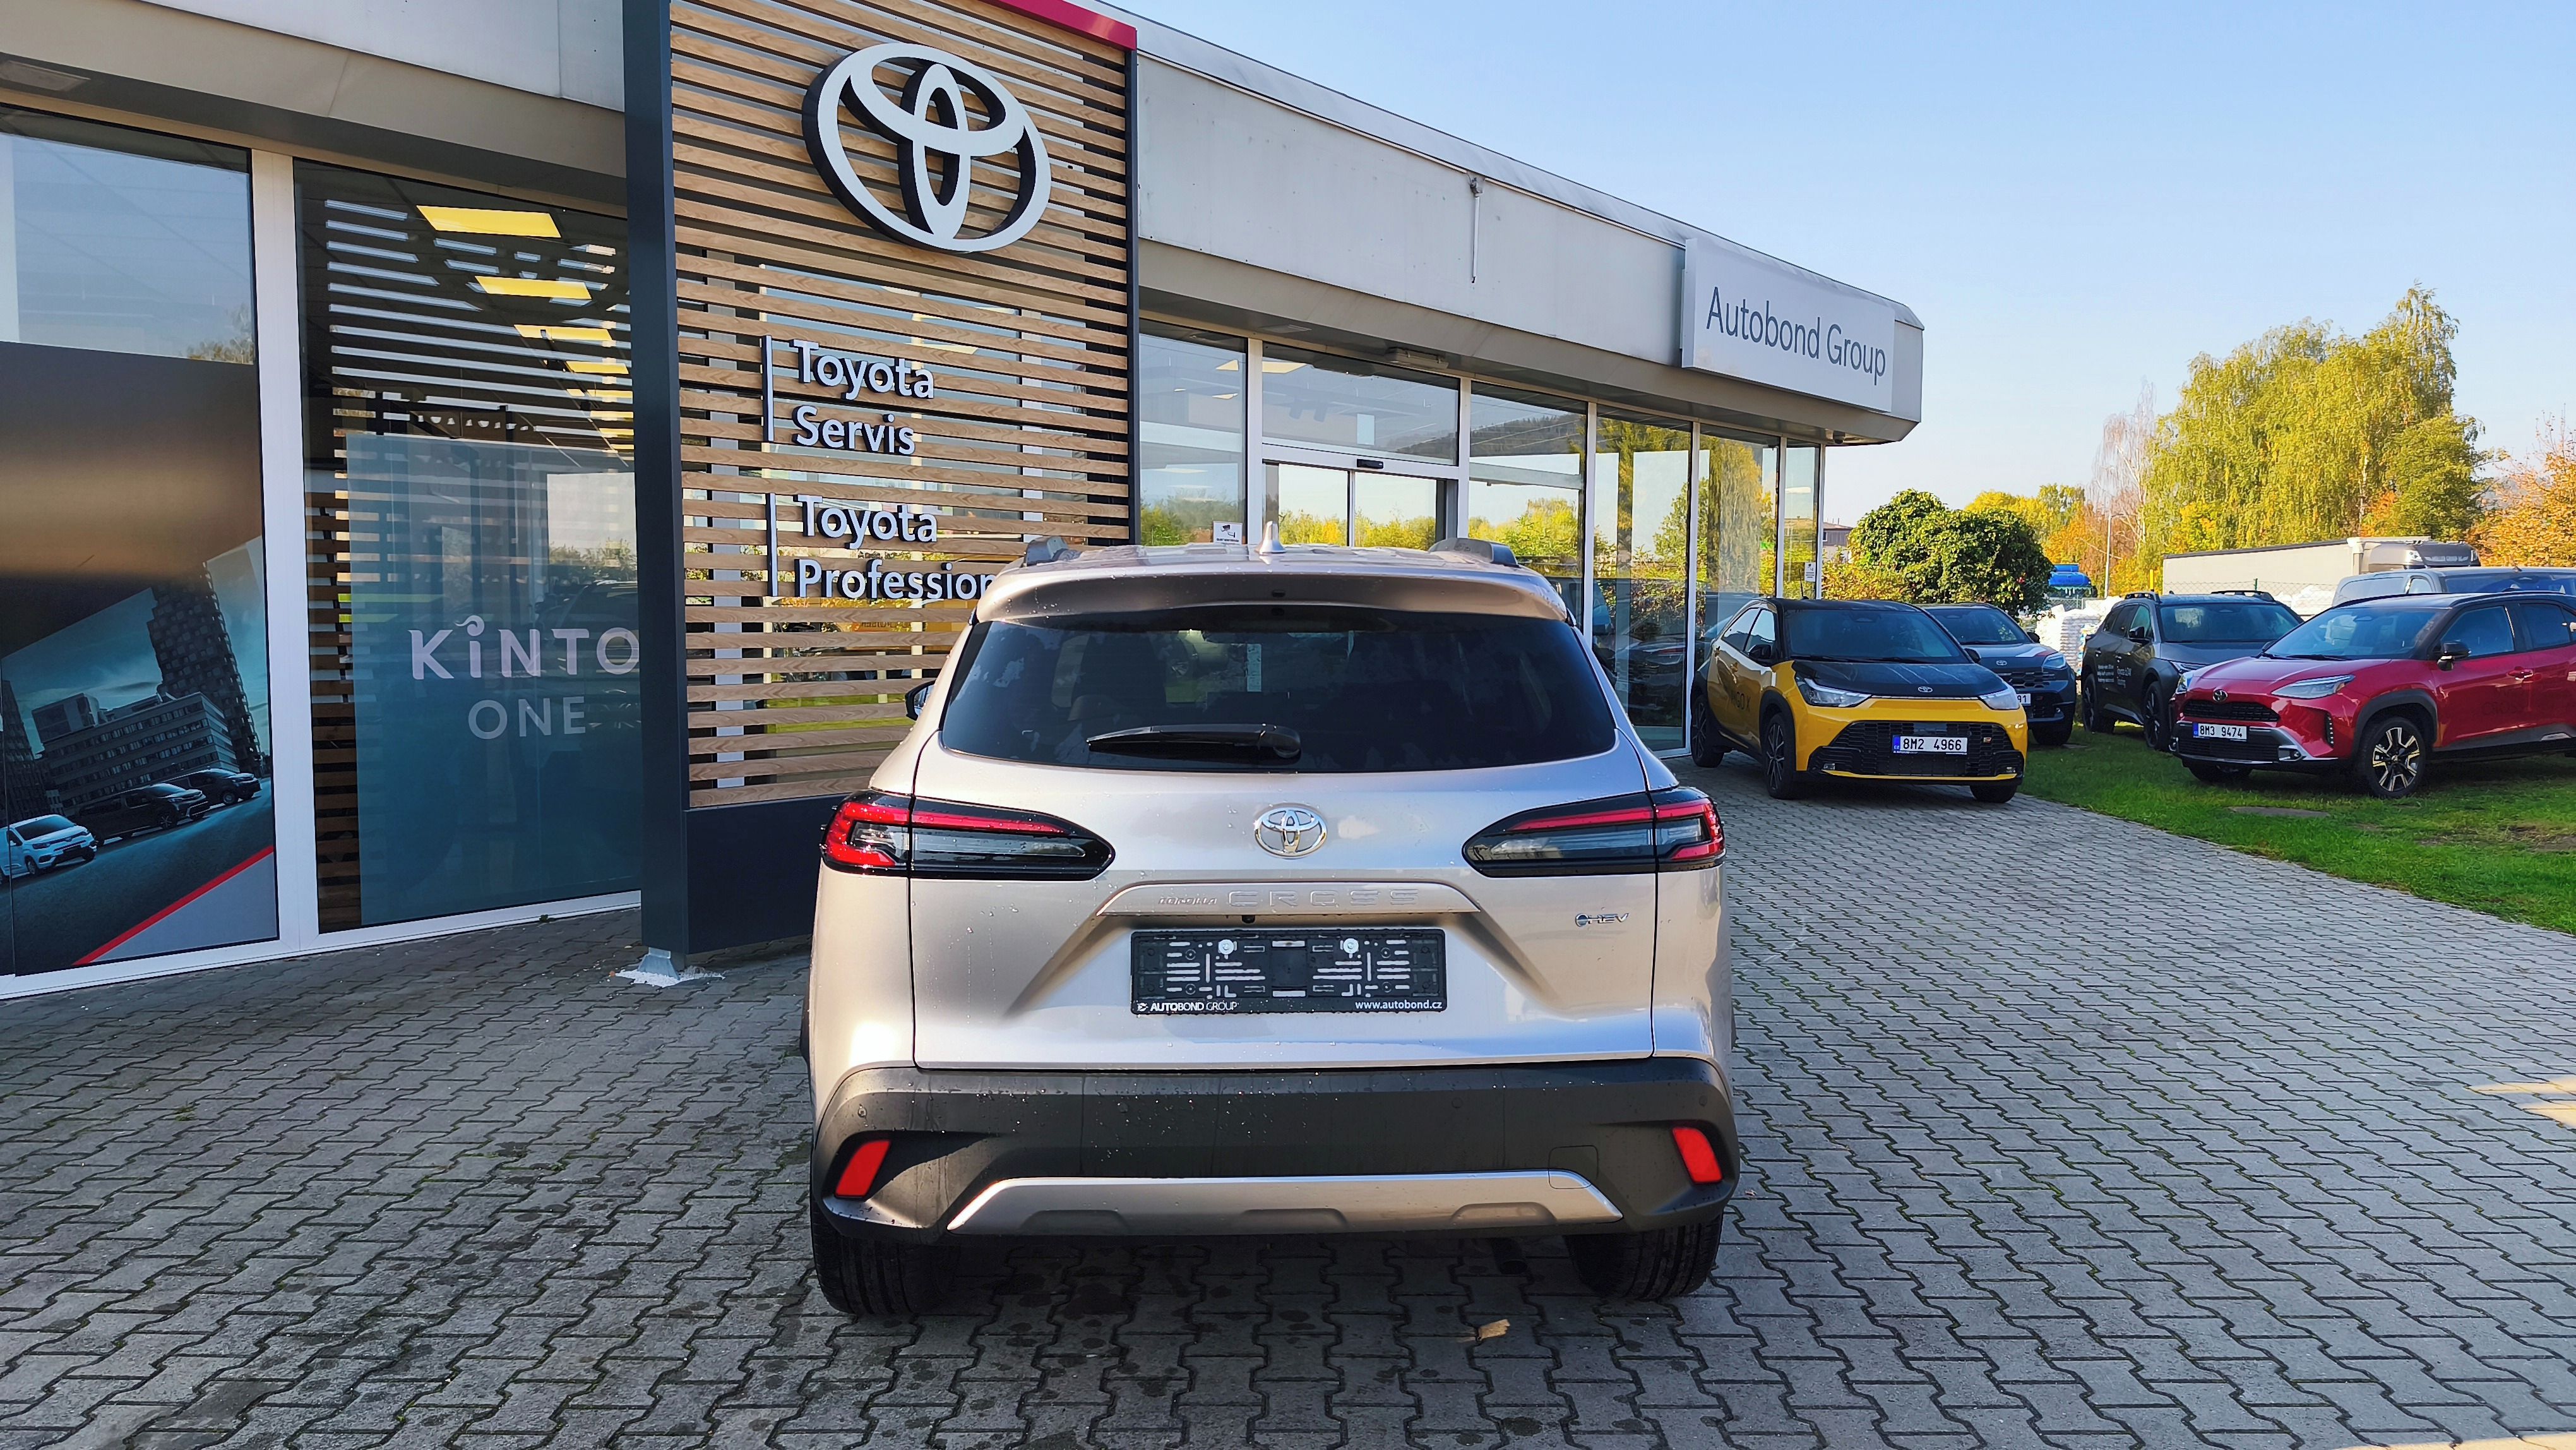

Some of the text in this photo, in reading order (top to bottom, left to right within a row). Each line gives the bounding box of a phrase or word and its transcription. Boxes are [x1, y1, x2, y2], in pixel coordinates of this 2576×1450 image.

[1706, 286, 1887, 386] Autobond Group
[791, 339, 934, 400] Toyota
[793, 405, 915, 455] Servis
[795, 494, 938, 549] Toyota
[468, 697, 586, 740] ONE
[2221, 727, 2243, 738] 9474
[1903, 738, 1962, 751] 8M2 4966
[1228, 889, 1419, 907] CROSS
[1150, 1002, 1237, 1012] AUTOBOND GROUP
[1355, 999, 1442, 1009] www.autobond.cz
